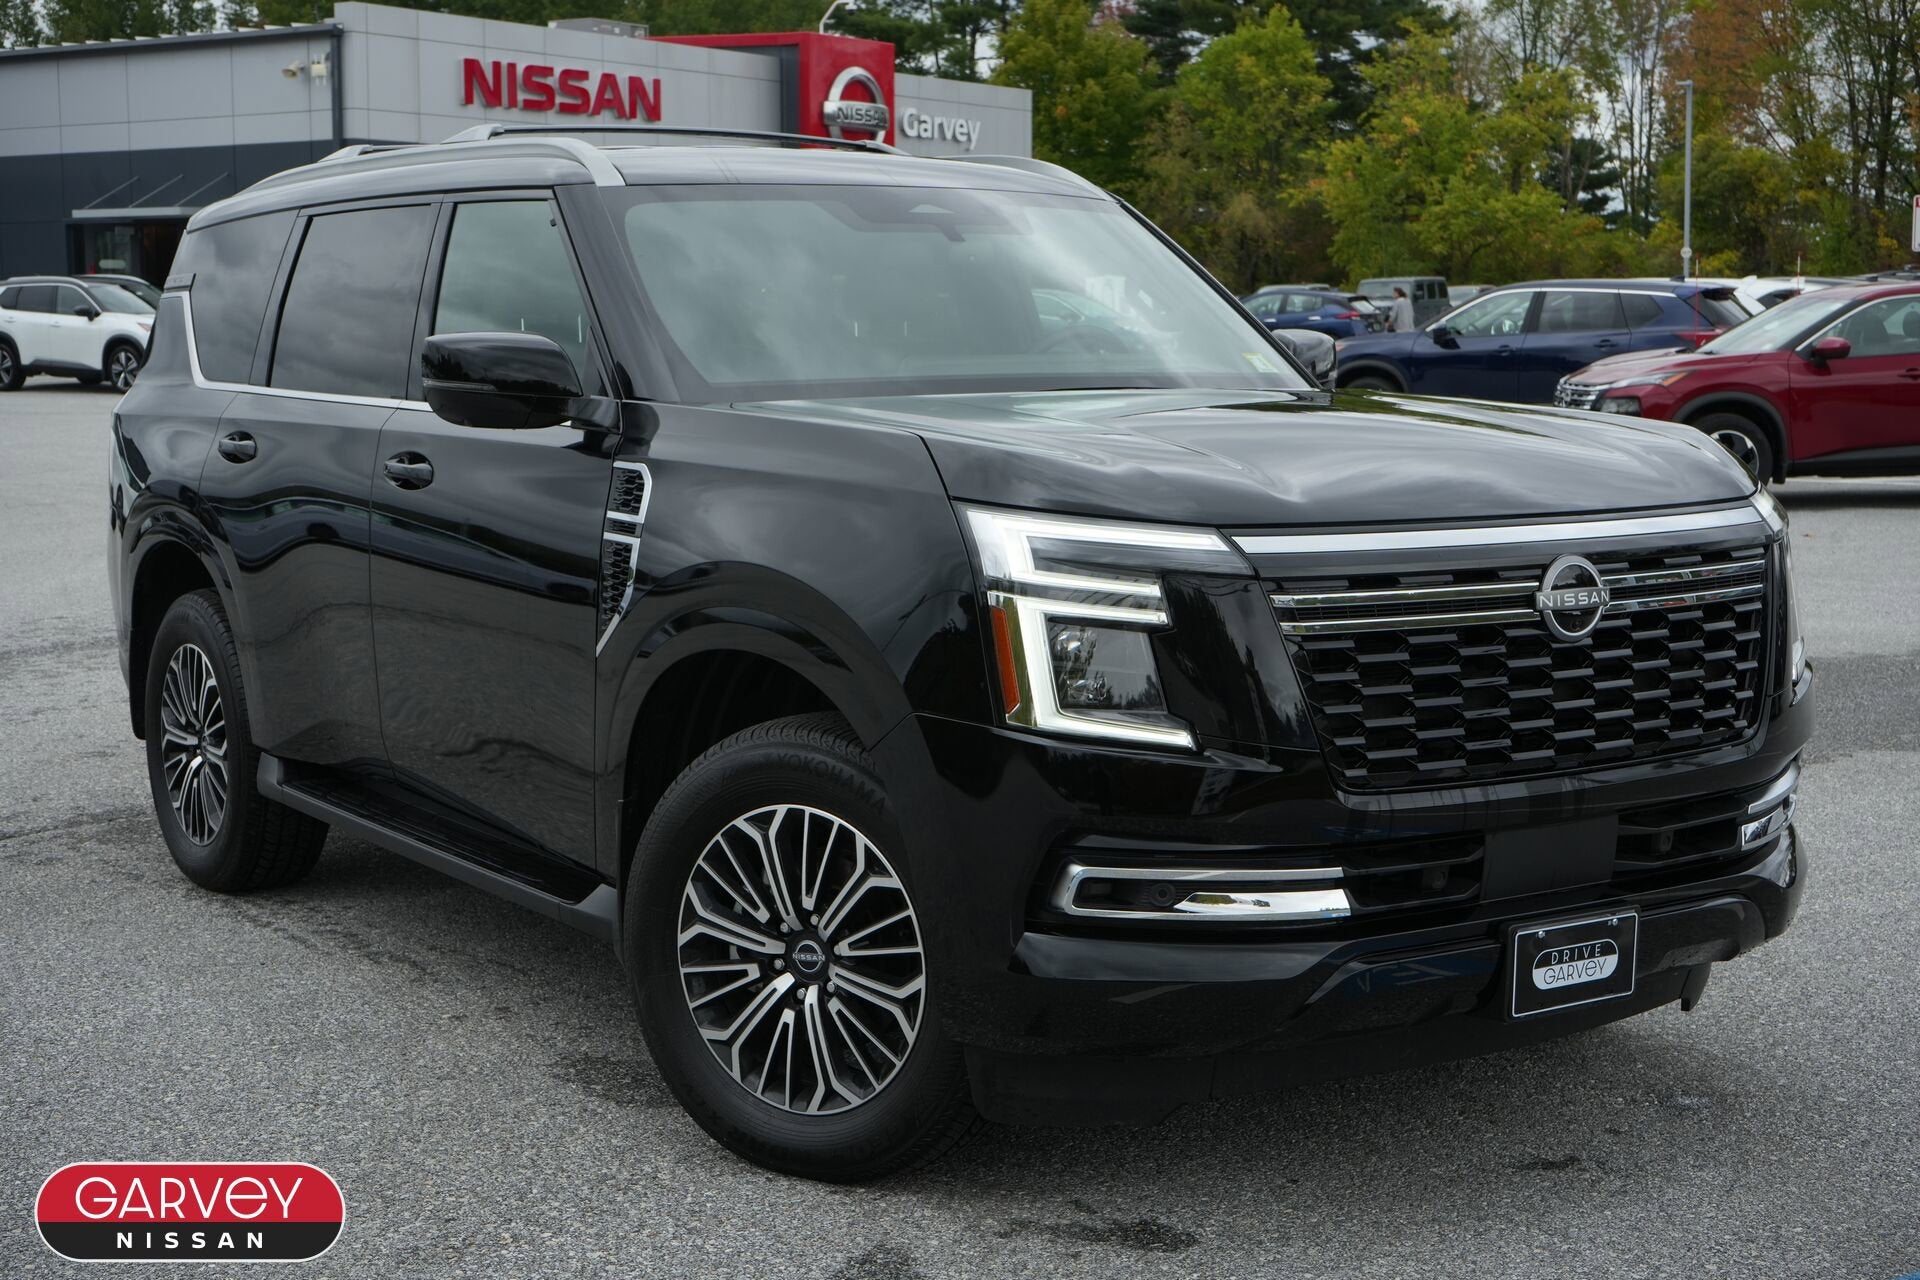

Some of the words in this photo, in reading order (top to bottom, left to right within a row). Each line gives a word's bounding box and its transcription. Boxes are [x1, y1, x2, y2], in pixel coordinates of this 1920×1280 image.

[463, 58, 661, 121] NISSAN
[836, 107, 888, 129] NISSAN
[902, 108, 981, 150] Garvey
[1540, 590, 1609, 607] NISSAN
[793, 953, 825, 961] NISSAN
[1551, 944, 1601, 964] DRIVE
